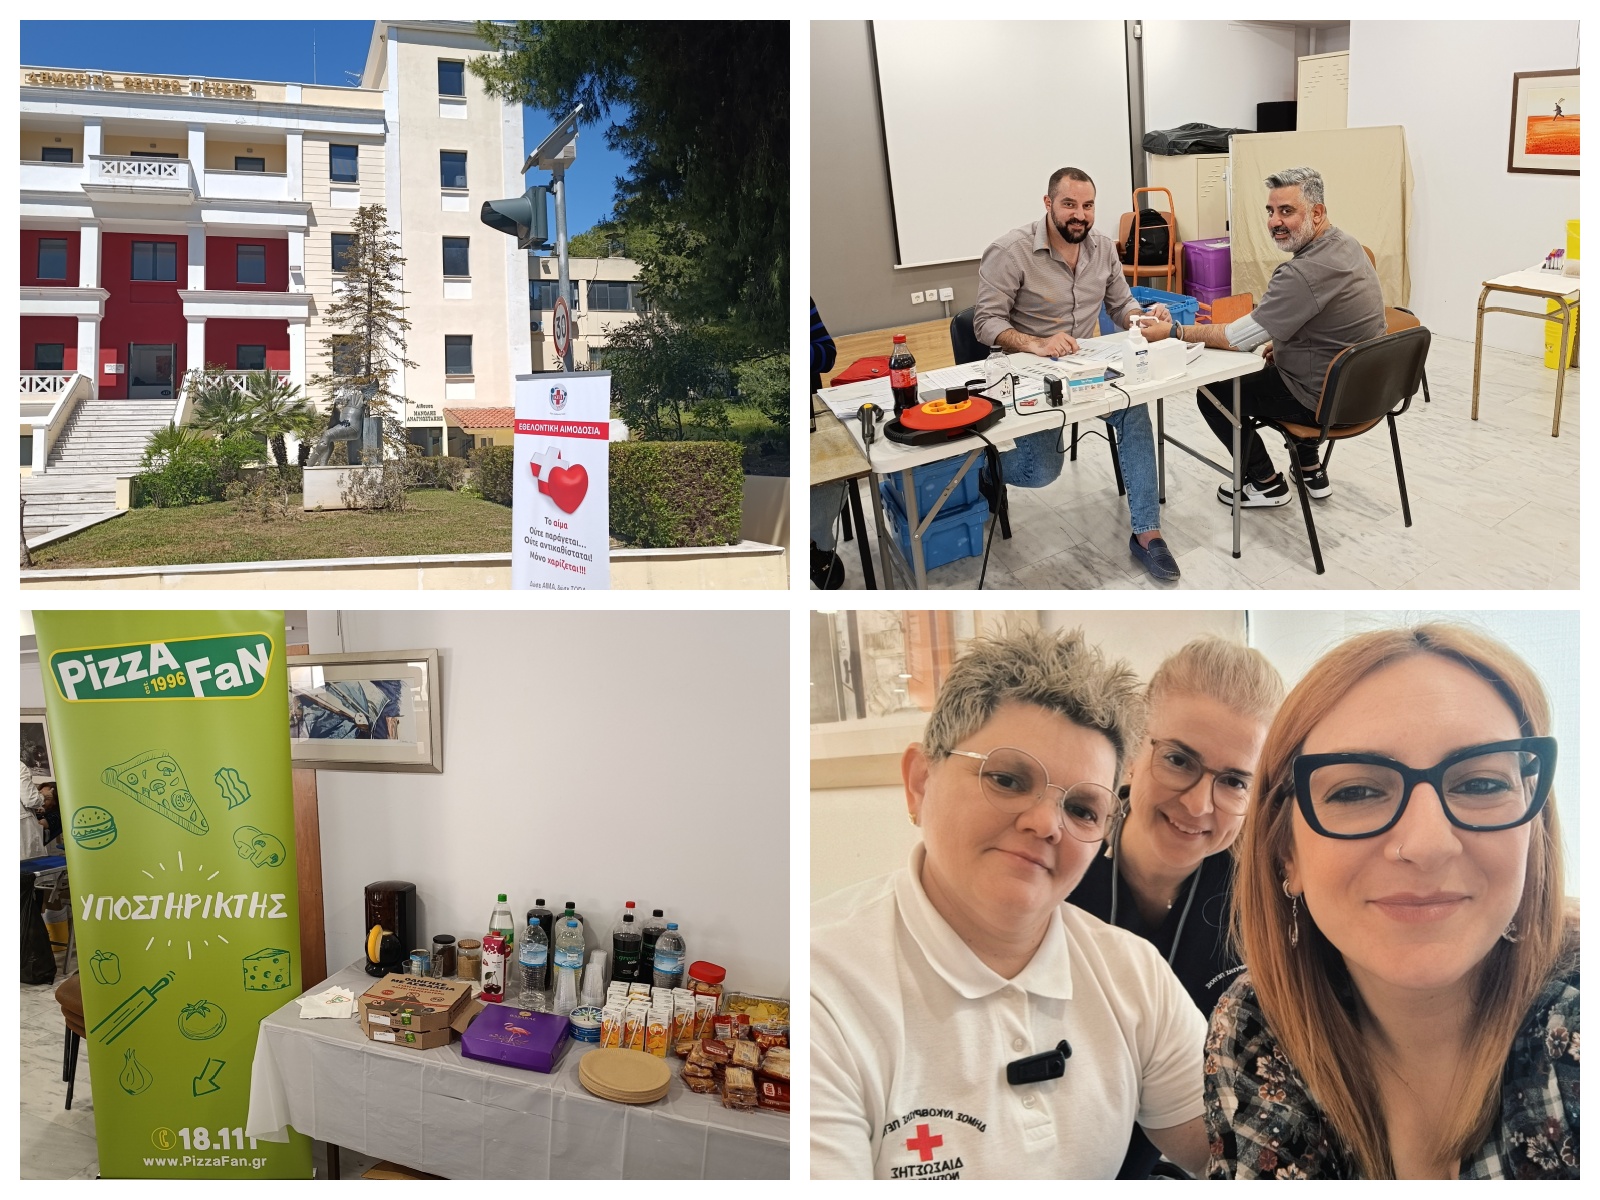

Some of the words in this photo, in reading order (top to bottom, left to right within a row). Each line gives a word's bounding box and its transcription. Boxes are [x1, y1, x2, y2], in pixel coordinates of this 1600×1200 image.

[28, 71, 114, 86] ΔΗΜΟΤΙΚΟ
[122, 76, 181, 90] ΘΕΑΤΡΟ
[190, 81, 254, 97] ΠΕΥΚΗΣ
[556, 314, 566, 340] 30
[518, 423, 558, 433] ΕΘΕΛΟΝΤΙΚΗ
[559, 425, 600, 435] ΑΙΜΟΔΟΣΙΑ
[544, 516, 552, 525] Το
[553, 519, 568, 529] αίμα
[529, 526, 544, 538] Ούτε
[545, 533, 587, 549] παράγεται...
[524, 536, 538, 547] Ούτε
[539, 542, 593, 562] αντικαθίσταται!
[529, 551, 546, 563] Μόνο
[547, 557, 586, 575] χαρίζεται!!!
[150, 671, 187, 693] 1996
[80, 891, 288, 921] ΥΠΟΣΤΗΡΙΚΤΗΣ
[404, 977, 448, 987] ΟΔΗΓΗΣΕ
[406, 981, 455, 991] ΑΣΦΑΛΕΙΑ
[142, 1155, 268, 1170] www.PizzaFan.gr
